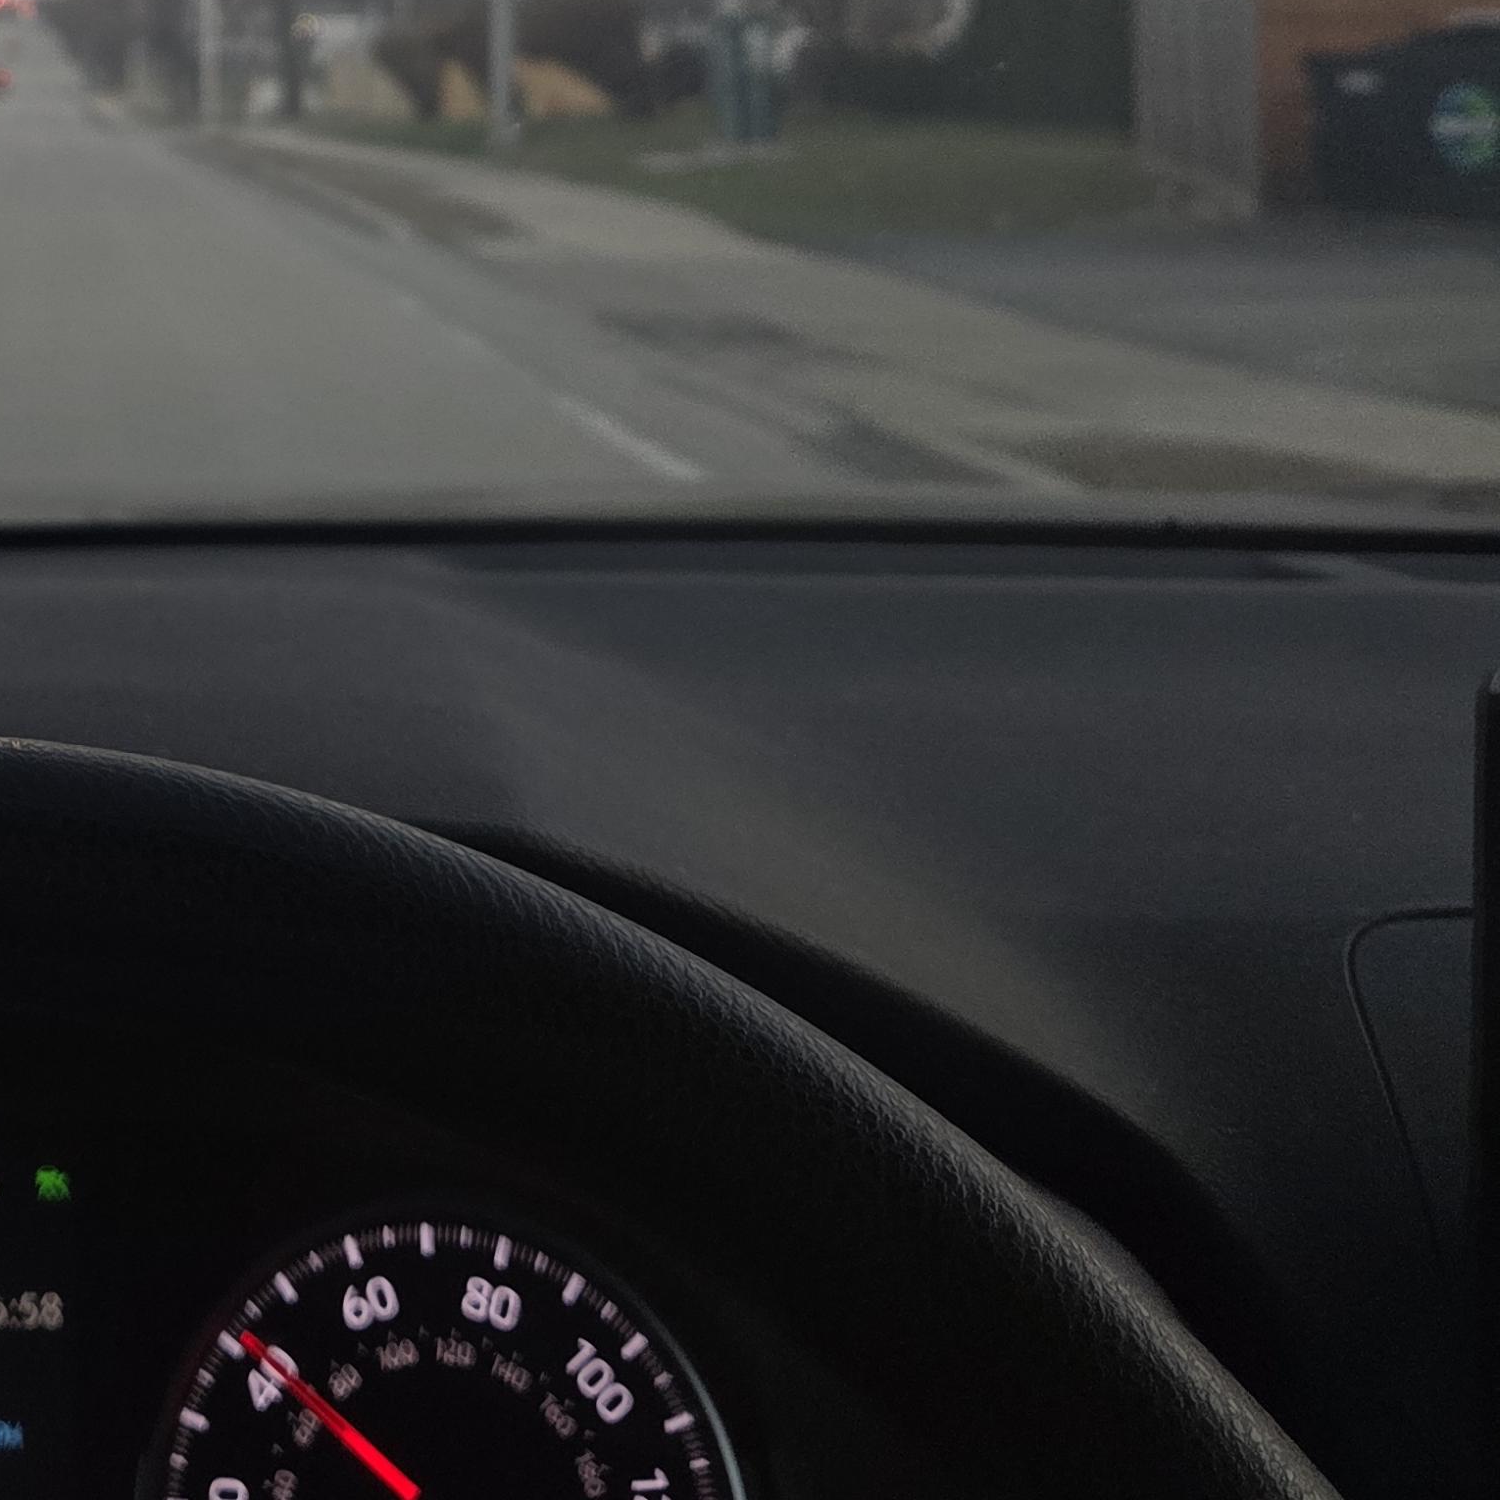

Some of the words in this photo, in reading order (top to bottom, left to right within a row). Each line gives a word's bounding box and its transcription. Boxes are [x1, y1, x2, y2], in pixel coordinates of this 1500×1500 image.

[342, 1276, 399, 1330] 60
[461, 1276, 521, 1331] 80
[566, 1337, 634, 1424] 100
[209, 1477, 249, 1500] 0
